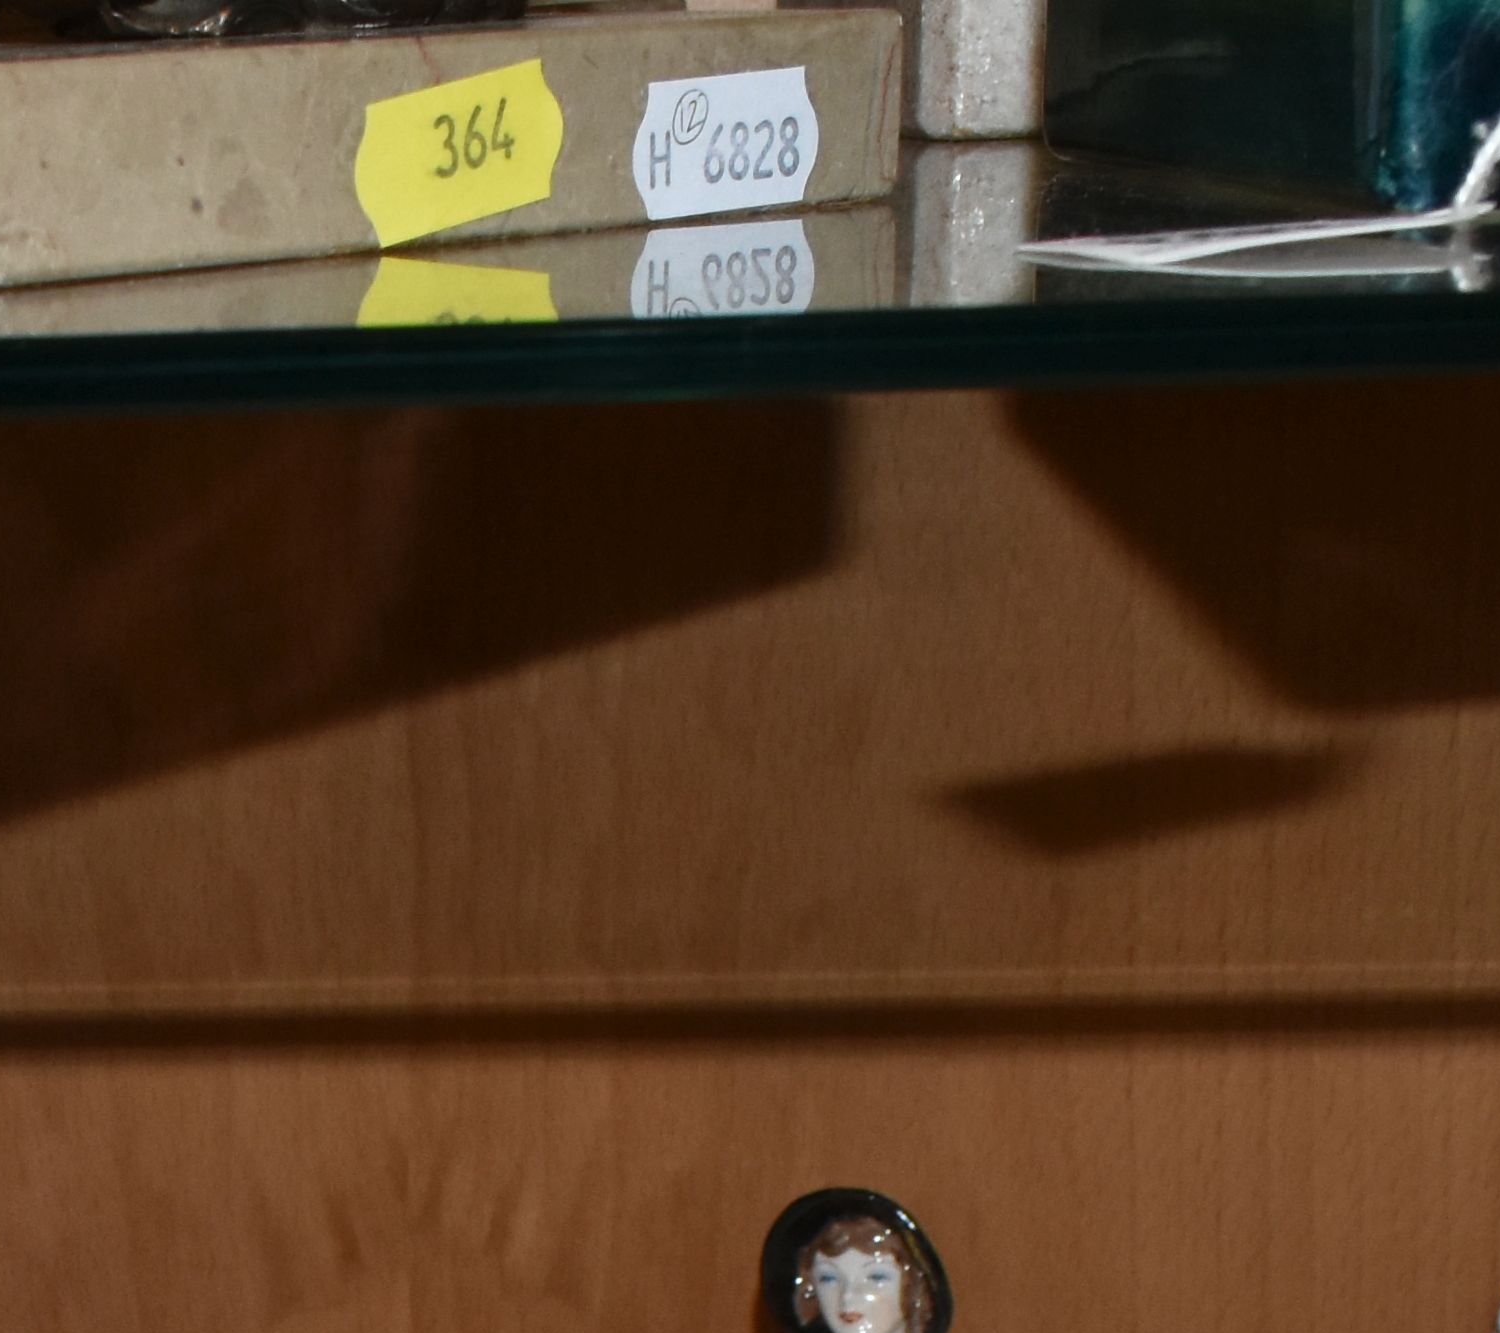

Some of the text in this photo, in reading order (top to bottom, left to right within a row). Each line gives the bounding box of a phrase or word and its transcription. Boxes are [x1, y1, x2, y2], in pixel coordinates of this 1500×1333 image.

[433, 98, 515, 179] 364
[650, 116, 800, 189] H 6828
